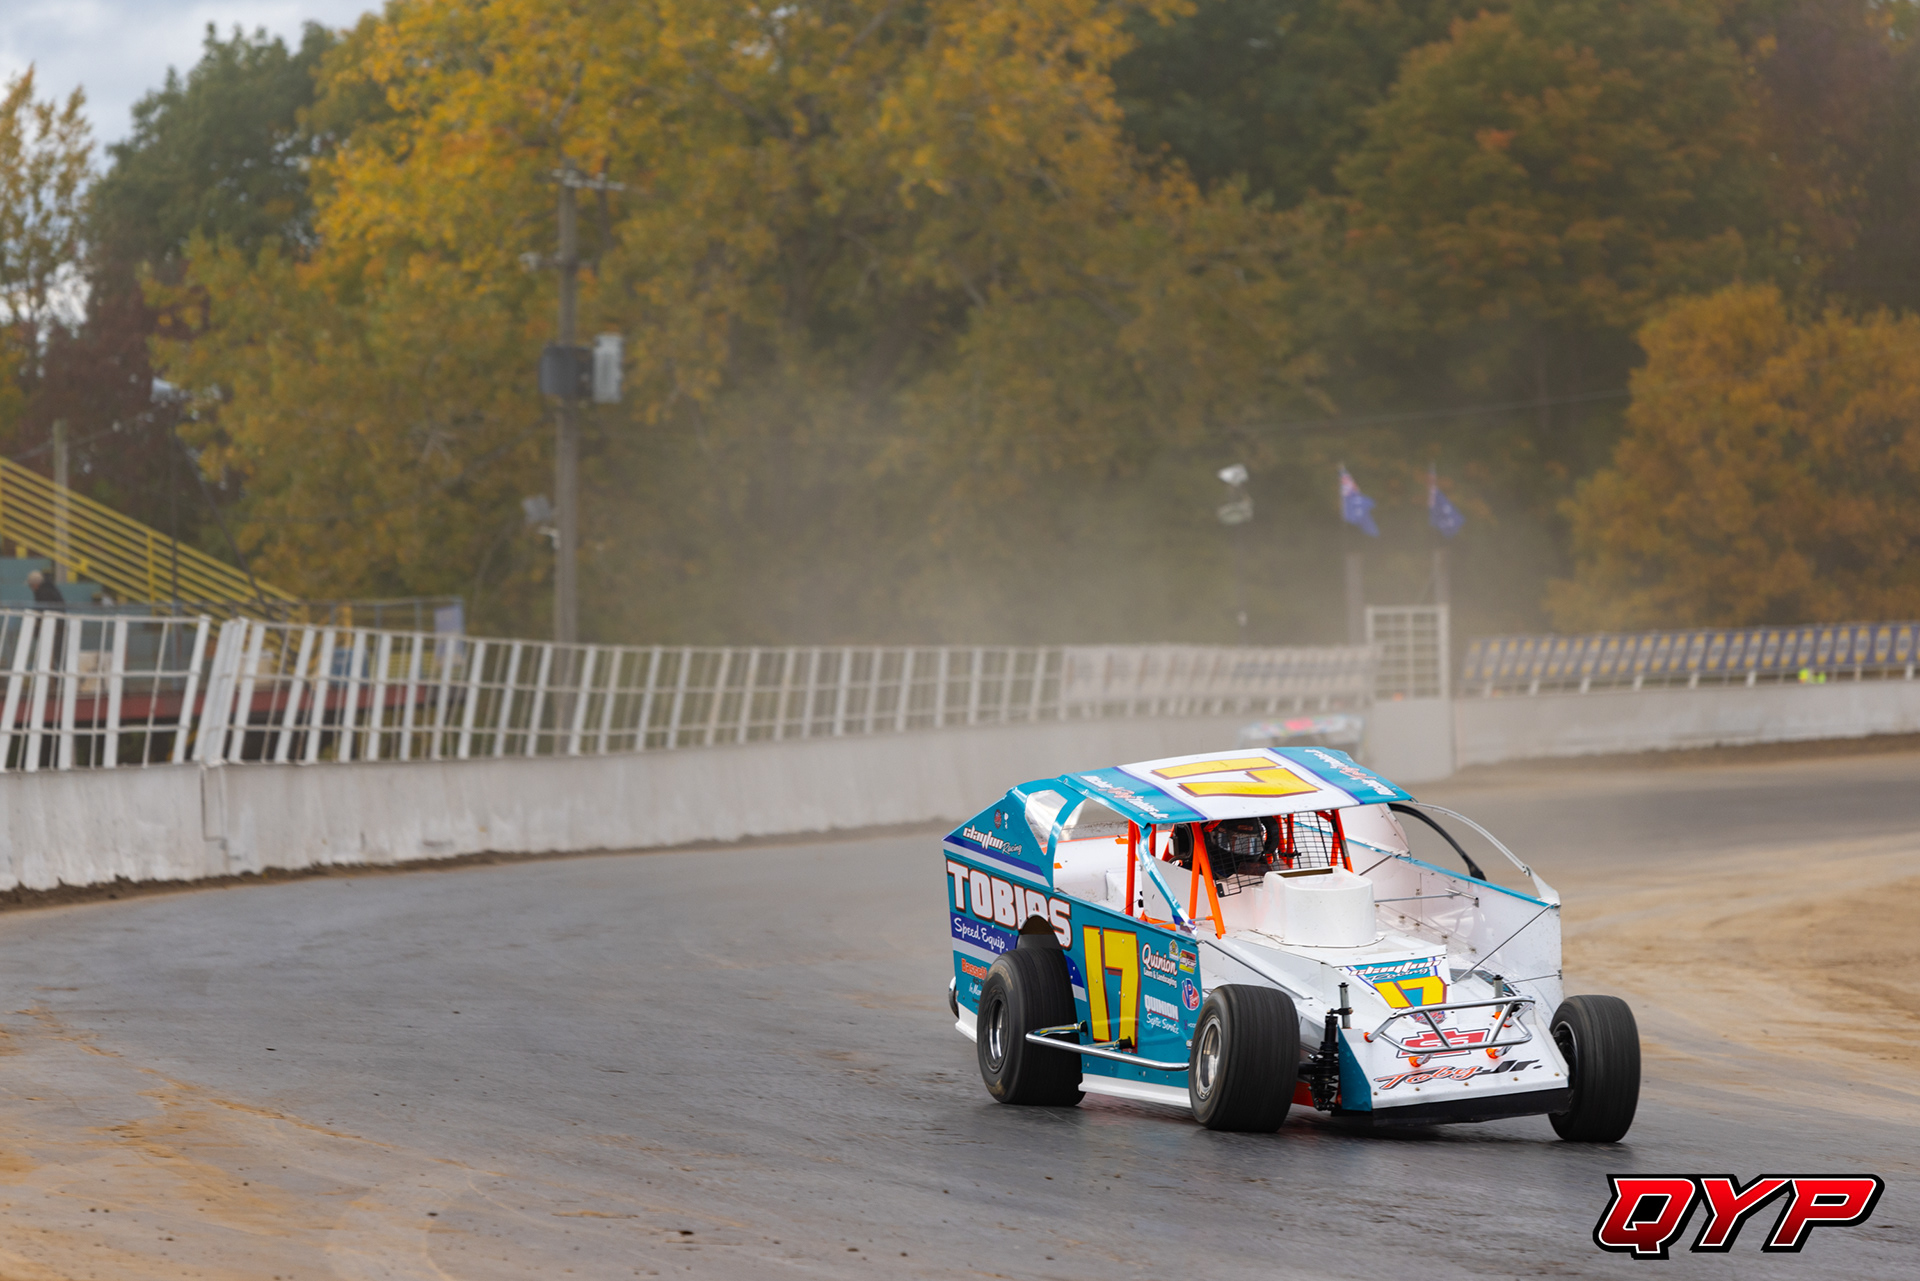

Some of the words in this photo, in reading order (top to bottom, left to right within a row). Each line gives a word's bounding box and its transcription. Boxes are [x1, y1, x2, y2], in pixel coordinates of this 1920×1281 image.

[1151, 757, 1322, 798] 17
[947, 859, 1072, 950] TOBIAS
[954, 918, 981, 940] Speed
[1083, 925, 1140, 1053] 17
[1373, 975, 1447, 1009] 17
[1144, 994, 1179, 1020] QUINION
[1374, 1065, 1483, 1090] Toby
